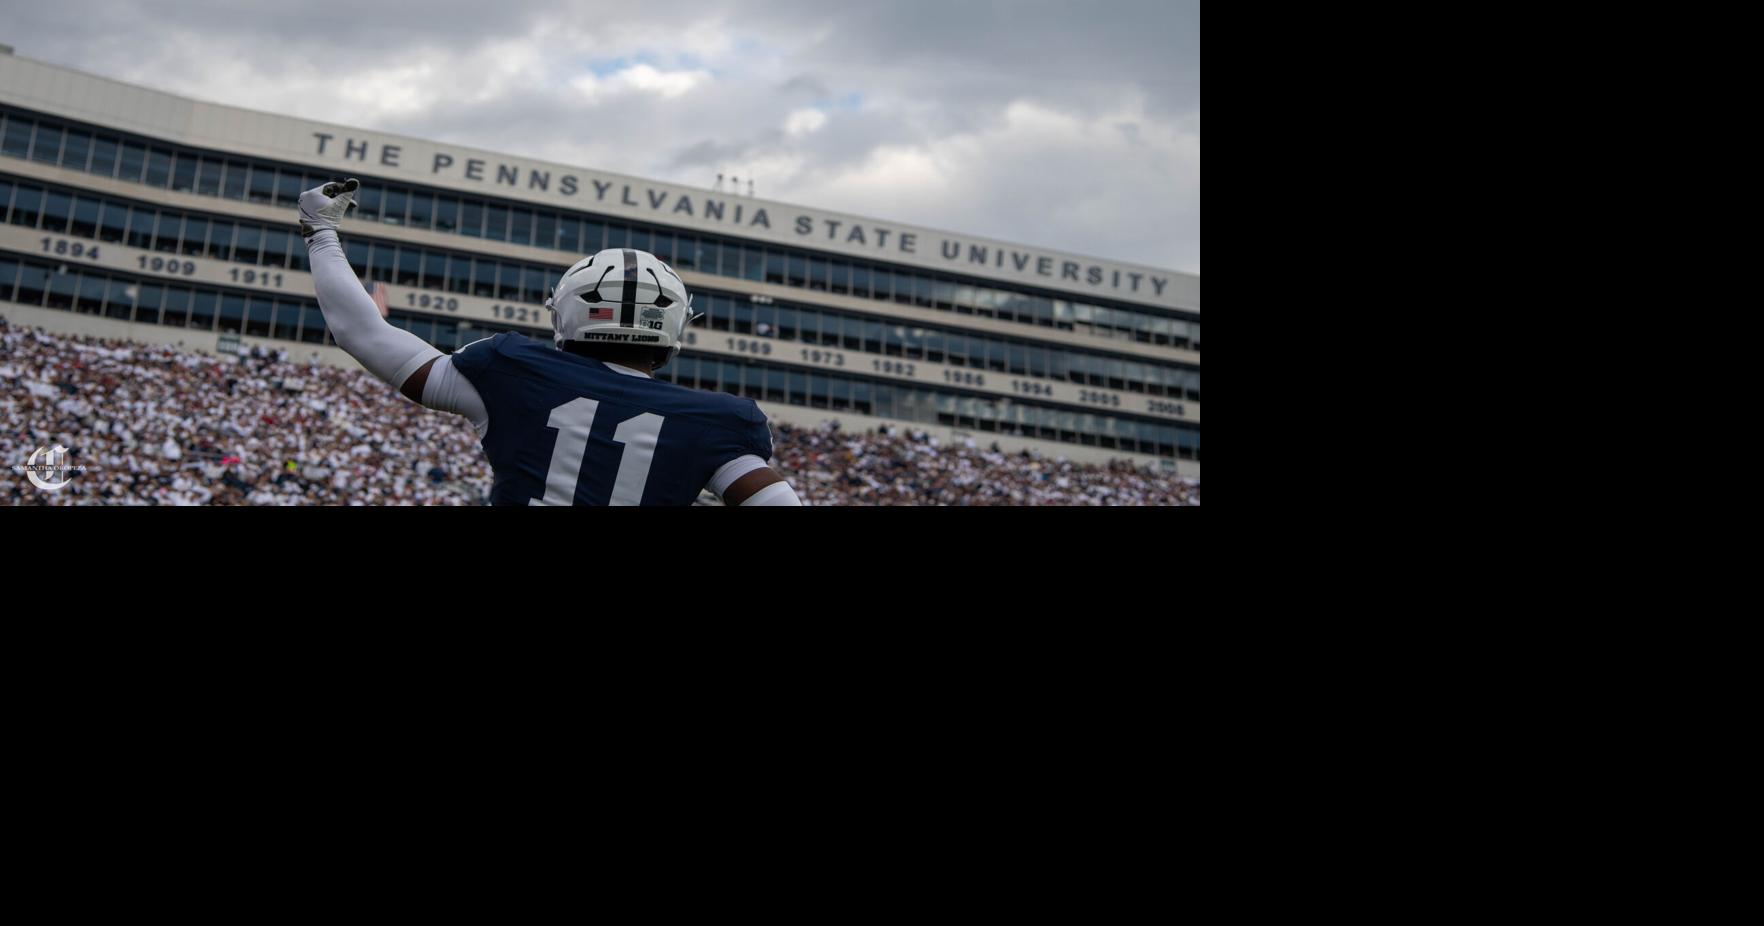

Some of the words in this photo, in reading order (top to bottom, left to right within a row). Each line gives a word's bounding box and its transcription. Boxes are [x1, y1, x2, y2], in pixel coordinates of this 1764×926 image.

[312, 132, 402, 167] THE
[432, 153, 771, 229] PENNSYLVANIA
[794, 215, 917, 253] STATE
[941, 240, 1170, 297] UNIVERSITY
[40, 236, 100, 261] 1894
[137, 254, 196, 276] 1909
[229, 267, 285, 288] 1911
[406, 293, 459, 312] 1920
[491, 304, 541, 323] 1921
[801, 348, 845, 367] 1973
[1011, 380, 1053, 397] 1994
[584, 332, 629, 342] NITTANY
[631, 334, 660, 343] LIONS
[529, 397, 665, 506] 11
